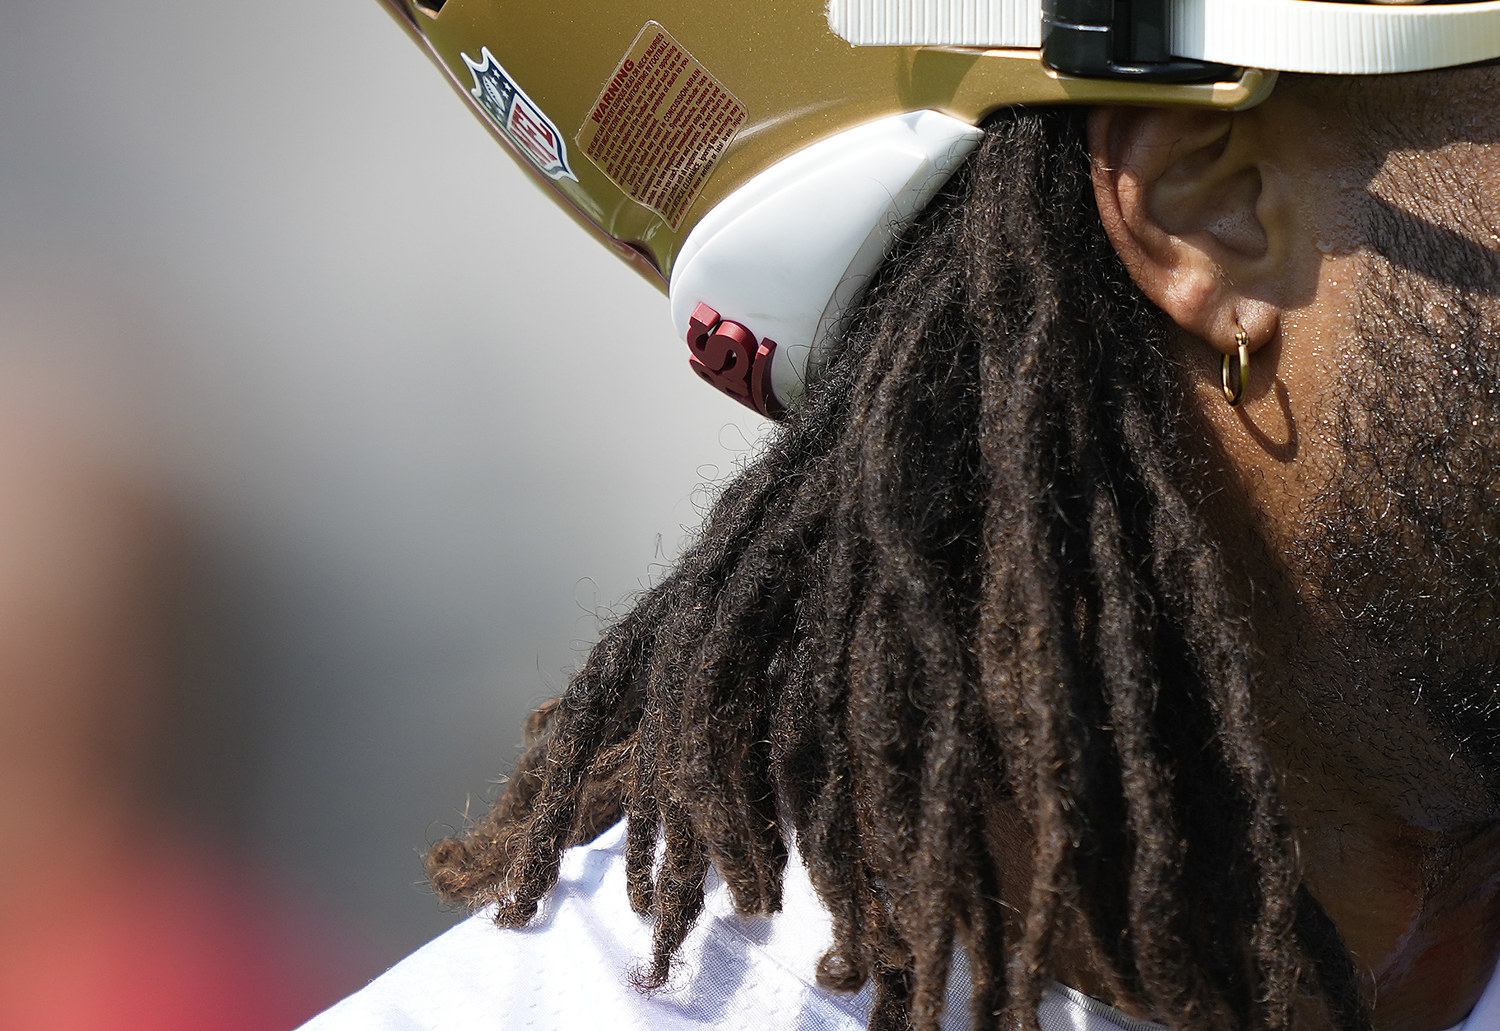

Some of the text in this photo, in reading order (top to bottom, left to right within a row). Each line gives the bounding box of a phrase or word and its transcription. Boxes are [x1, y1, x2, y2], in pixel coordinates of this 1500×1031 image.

[623, 75, 635, 91] HEAD
[632, 67, 640, 78] OR
[636, 54, 649, 71] NECK
[645, 33, 664, 57] INJURIES
[645, 75, 656, 90] spear
[654, 68, 661, 77] an
[658, 45, 678, 70] opposing
[645, 64, 652, 73] IN
[654, 80, 662, 92] and
[659, 69, 670, 83] such
[667, 60, 676, 71] use
[674, 51, 682, 62] can
[667, 72, 678, 88] death
[679, 57, 689, 69] you
[696, 75, 708, 87] loss
[591, 59, 635, 123] WARNING
[663, 68, 702, 122] CONCUSSION-BRAIN
[692, 113, 702, 126] stop
[699, 96, 715, 117] playing
[711, 86, 720, 98] and
[698, 121, 707, 130] Do
[703, 112, 712, 123] not
[708, 98, 722, 115] return
[701, 130, 711, 145] gone
[709, 119, 718, 132] and
[715, 111, 725, 123] you
[721, 99, 733, 112] have
[716, 115, 733, 136] warning
[729, 104, 740, 117] may
[721, 128, 733, 142] brain
[730, 109, 746, 128] injury.
